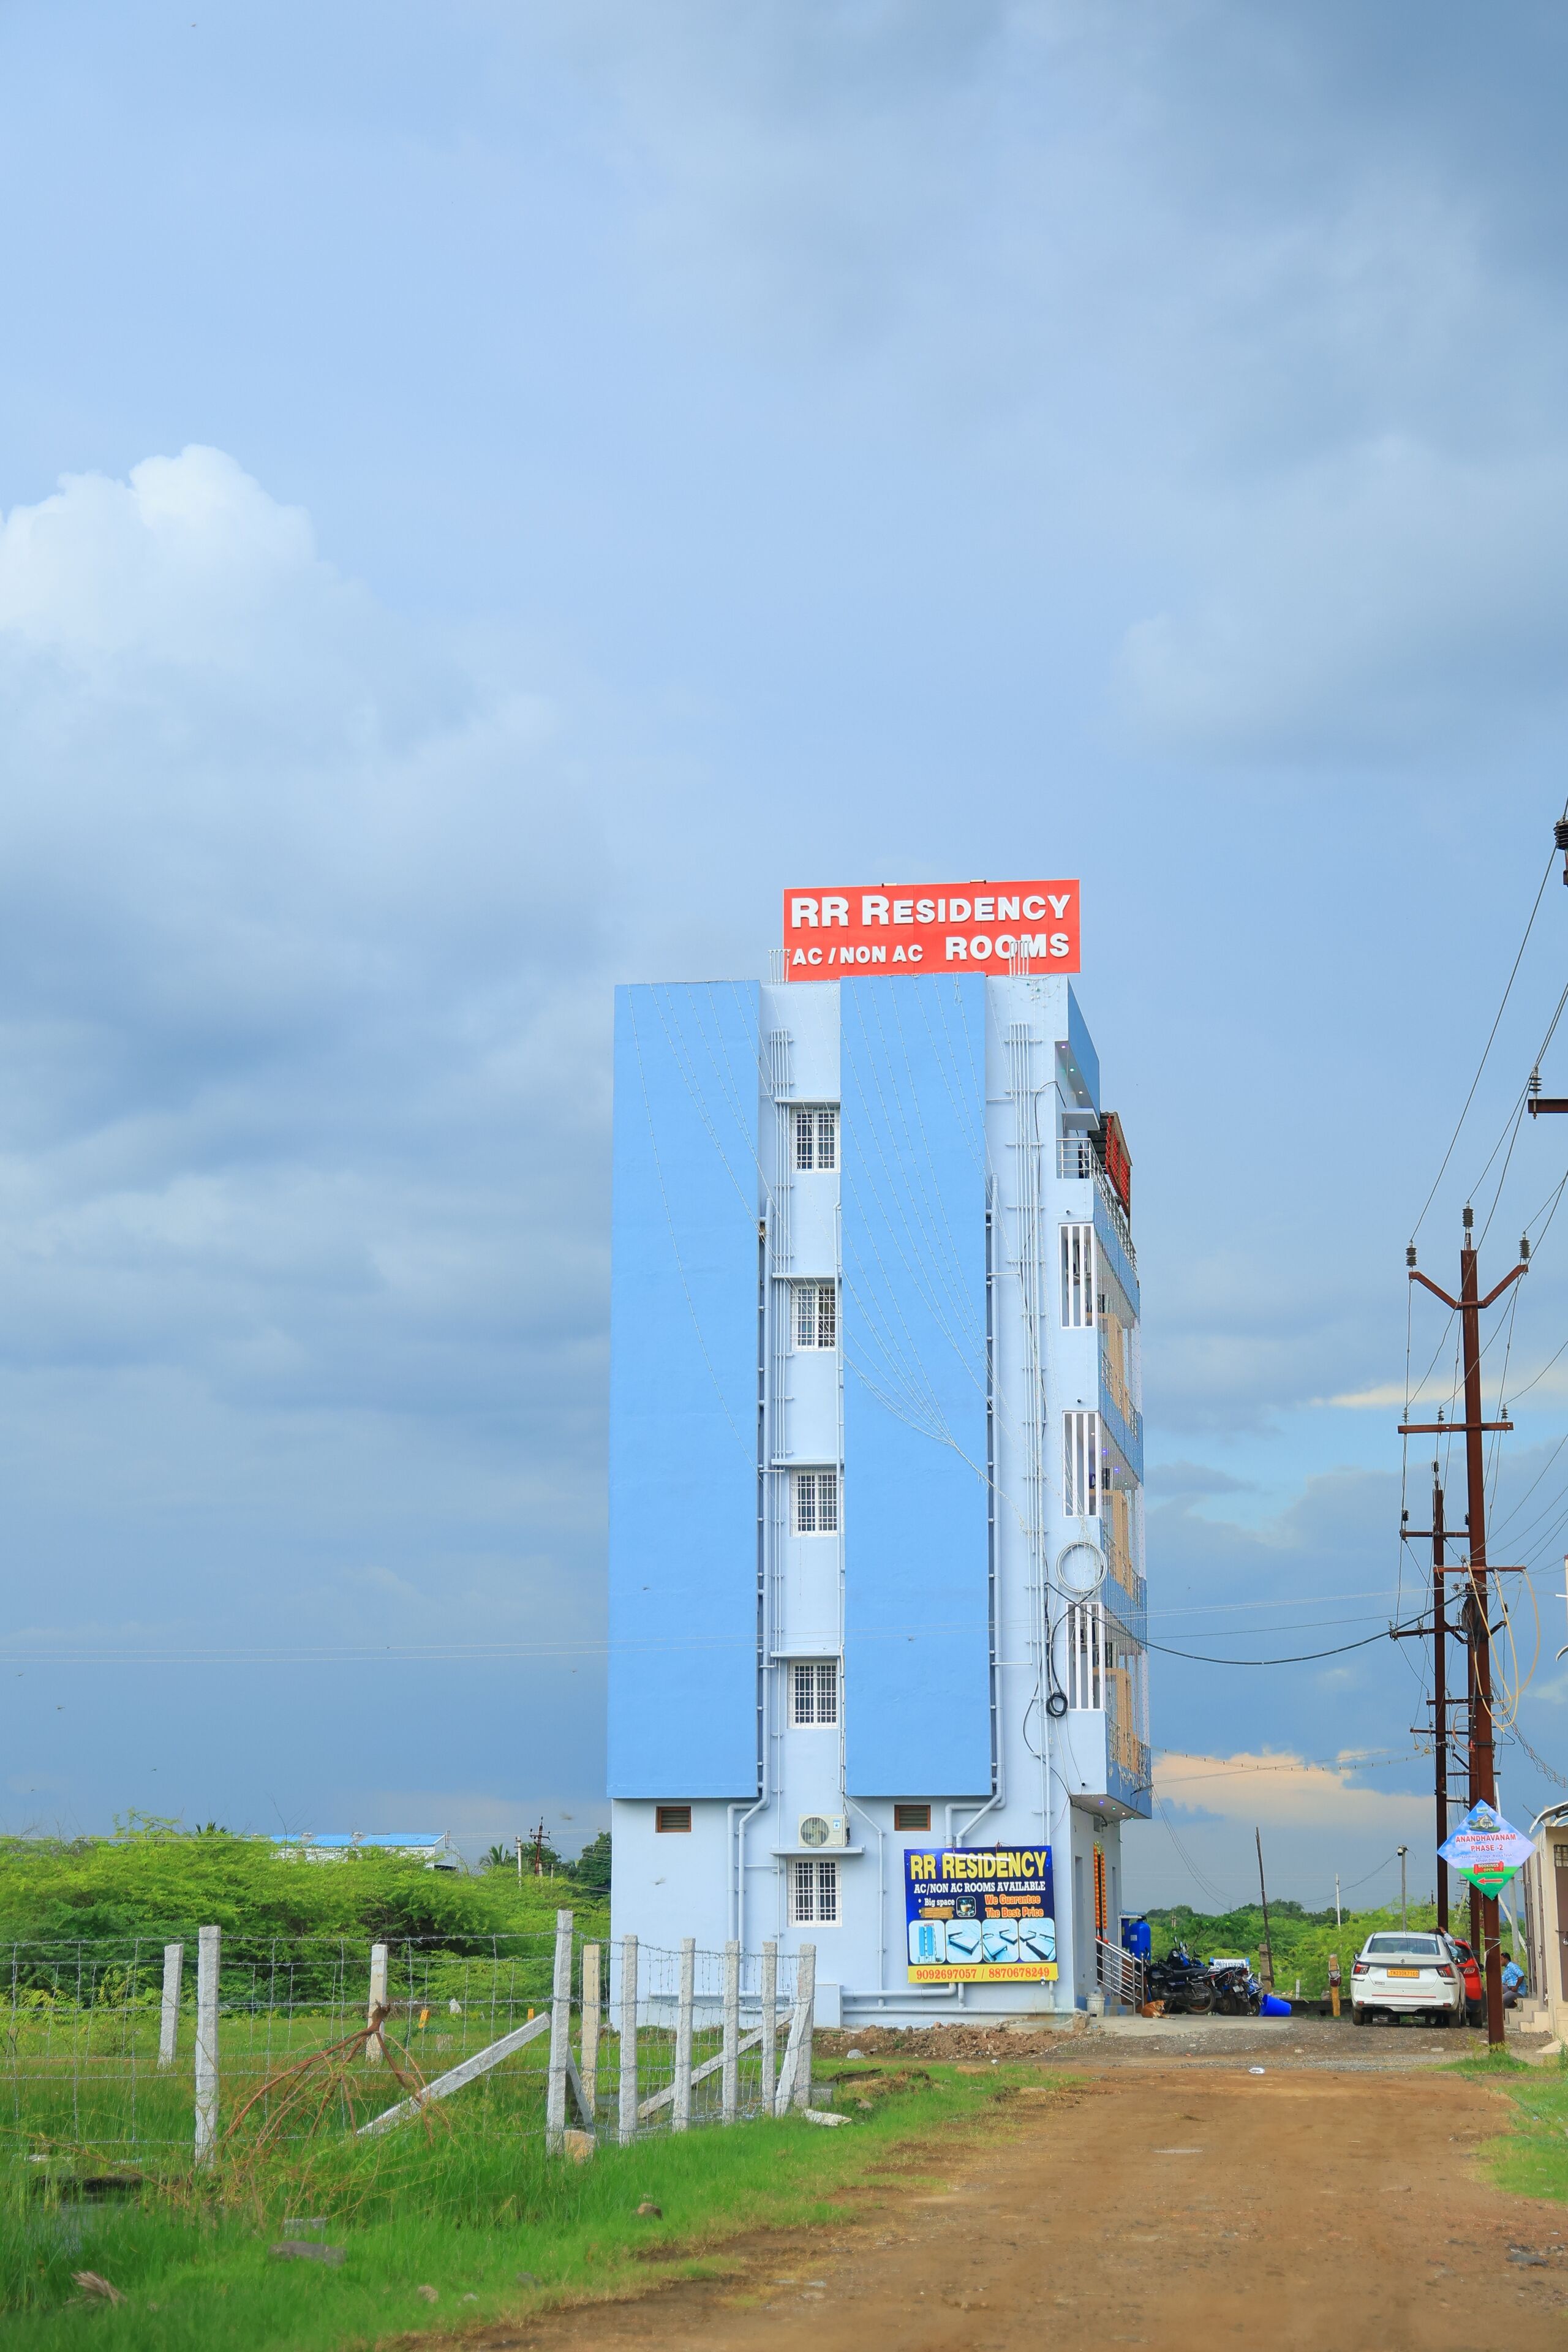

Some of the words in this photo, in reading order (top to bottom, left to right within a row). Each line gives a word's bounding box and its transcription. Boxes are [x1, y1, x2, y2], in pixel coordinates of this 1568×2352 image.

[791, 897, 849, 929] RR
[862, 894, 1071, 926] RESIDENCY
[892, 944, 924, 963] AC
[946, 933, 1070, 961] ROOMS
[1456, 1834, 1516, 1842] ANANDHAVANAM
[910, 1855, 937, 1880] RR
[942, 1852, 1047, 1880] RESIDENCY
[914, 1883, 949, 1895] AC/NON
[950, 1883, 963, 1893] AC
[964, 1882, 995, 1893] ROOMS
[997, 1881, 1046, 1891] AVAILABLE
[924, 1898, 935, 1907] Big
[984, 1894, 998, 1905] We
[999, 1894, 1041, 1904] Guarantee
[985, 1907, 1000, 1918] The
[1001, 1907, 1021, 1917] Best
[1022, 1907, 1044, 1917] Price
[916, 1969, 977, 1980] 9092697057
[989, 1967, 1050, 1978] 8870678249
